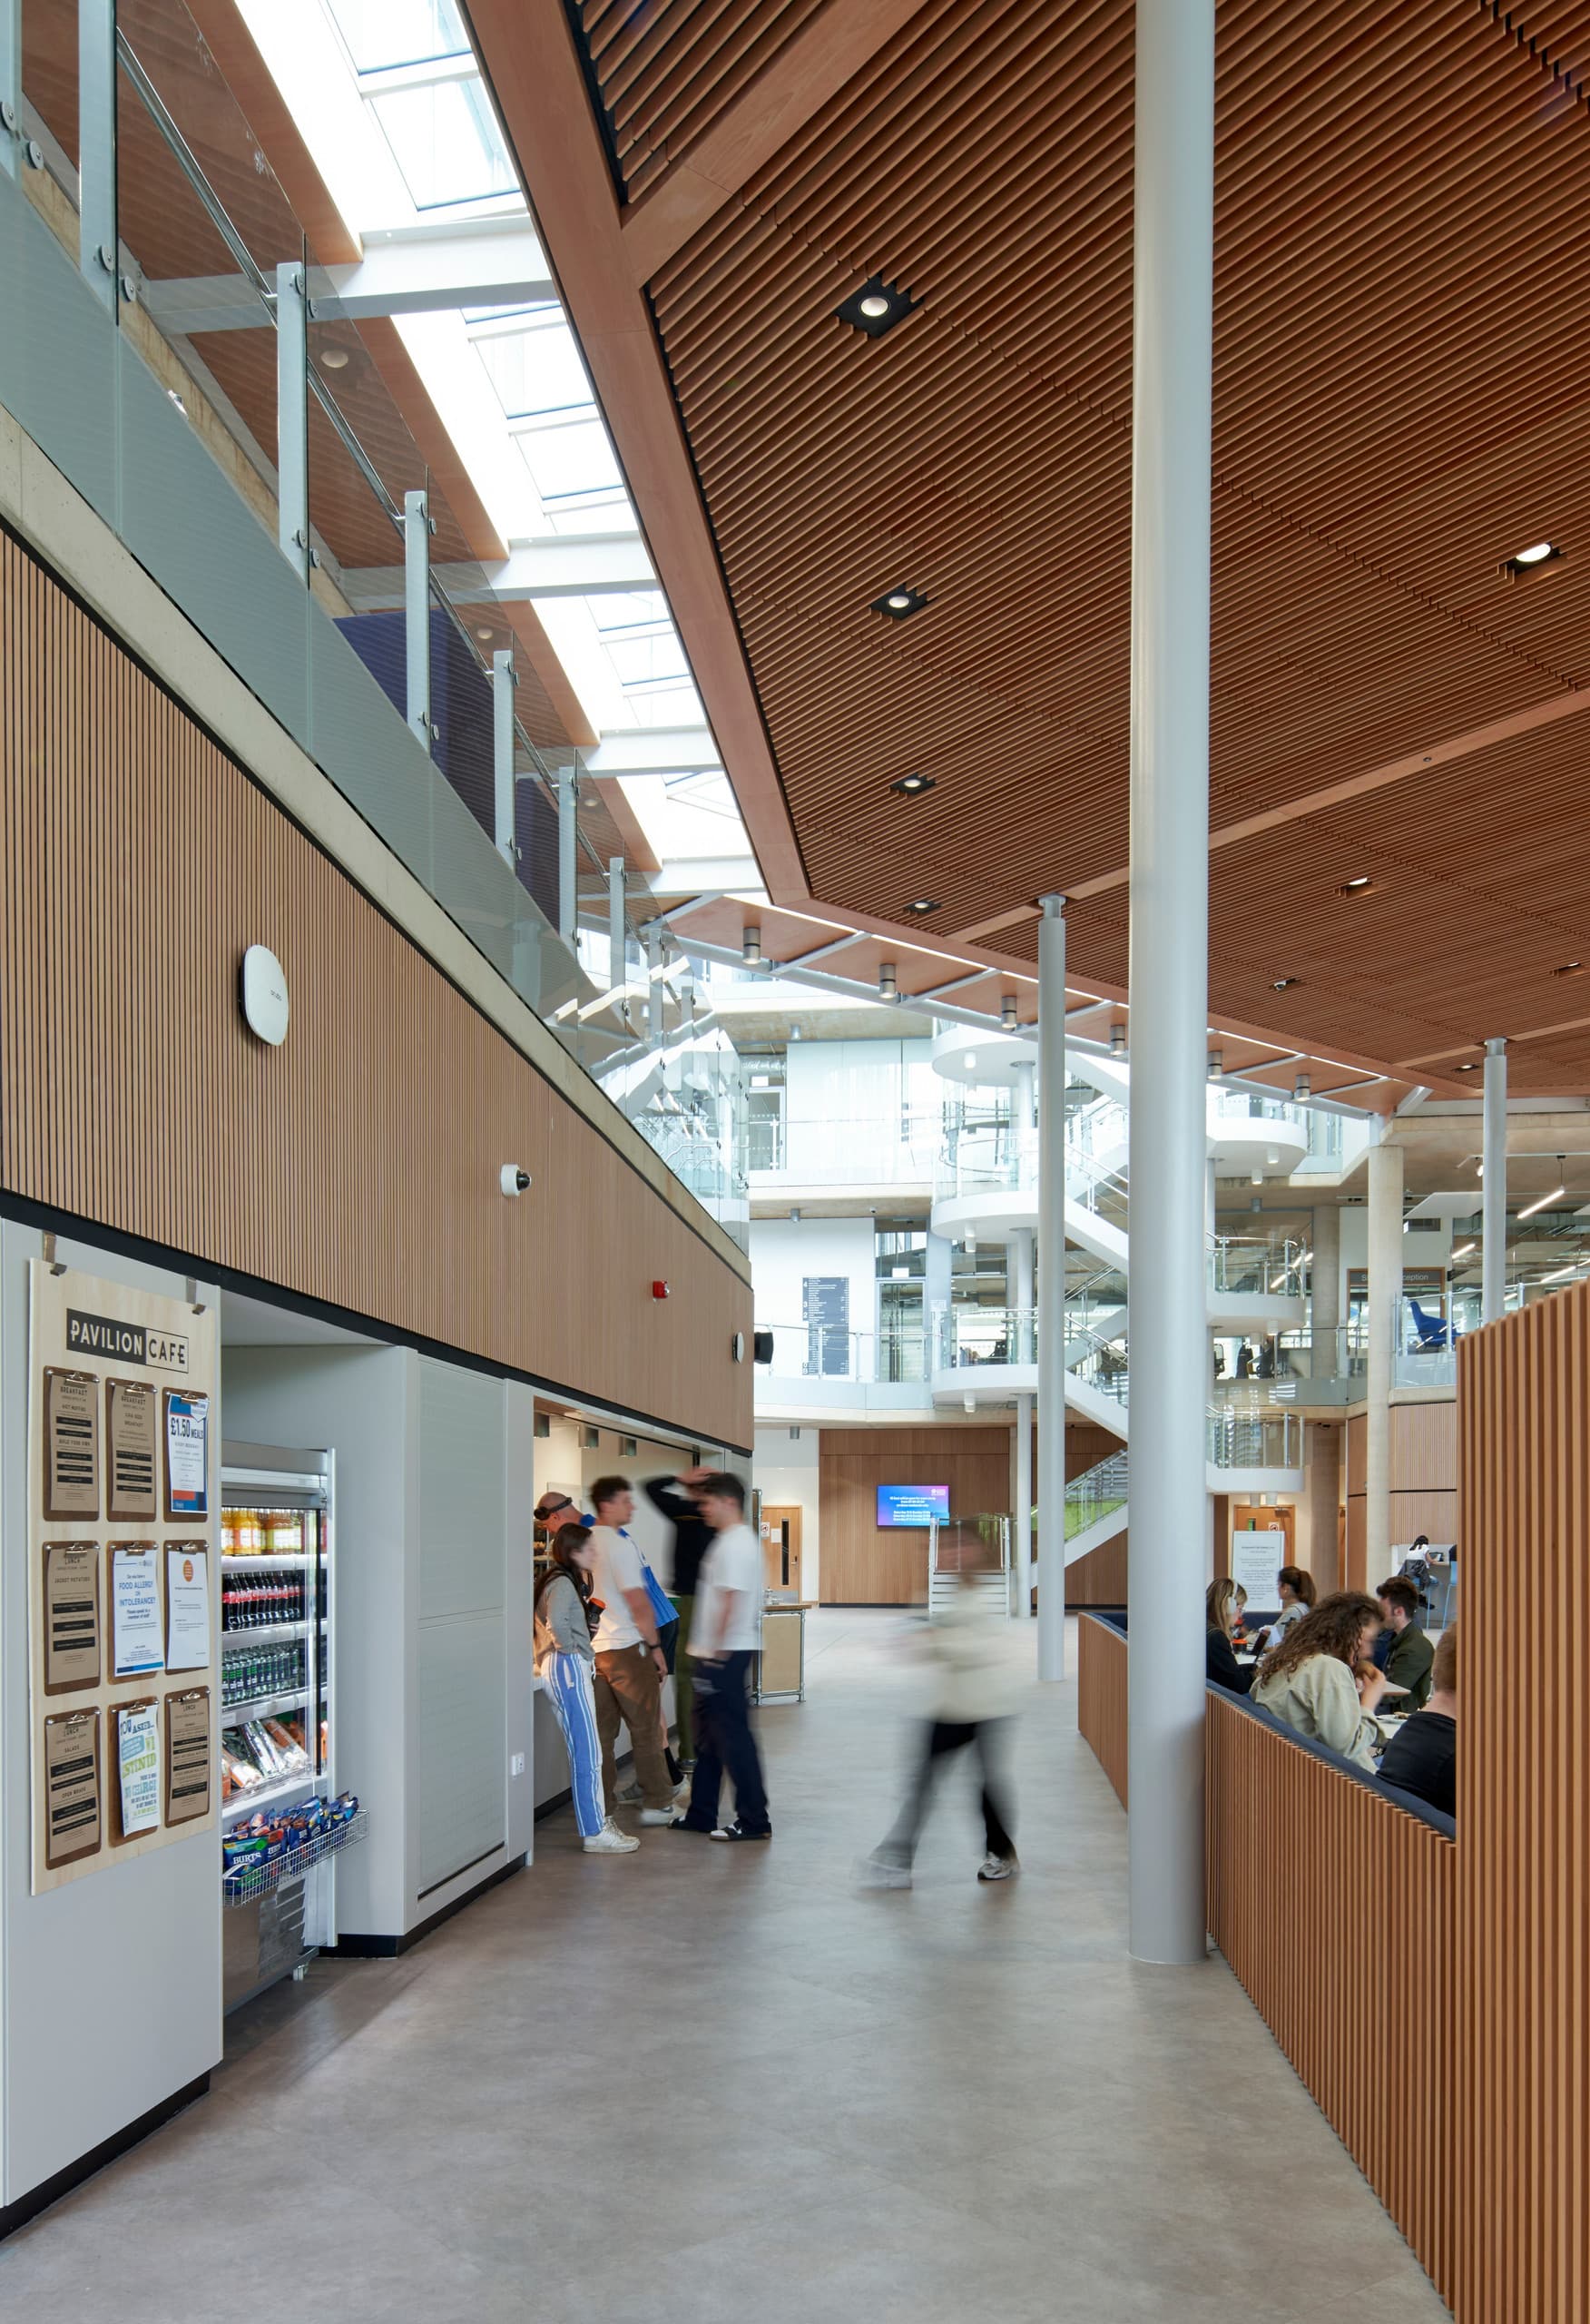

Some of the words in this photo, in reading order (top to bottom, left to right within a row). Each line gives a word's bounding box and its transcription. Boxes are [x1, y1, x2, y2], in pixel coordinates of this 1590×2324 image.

[1402, 1273, 1428, 1281] ception
[71, 1319, 142, 1356] PAVILION
[148, 1338, 185, 1364] CAFE
[60, 1386, 88, 1396] BREAKFAST
[121, 1395, 146, 1405] BREAKFAST
[171, 1417, 191, 1437] £1.50
[191, 1429, 203, 1439] MEALS
[133, 1581, 153, 1589] ALLERGY
[232, 1852, 261, 1865] BURTS
